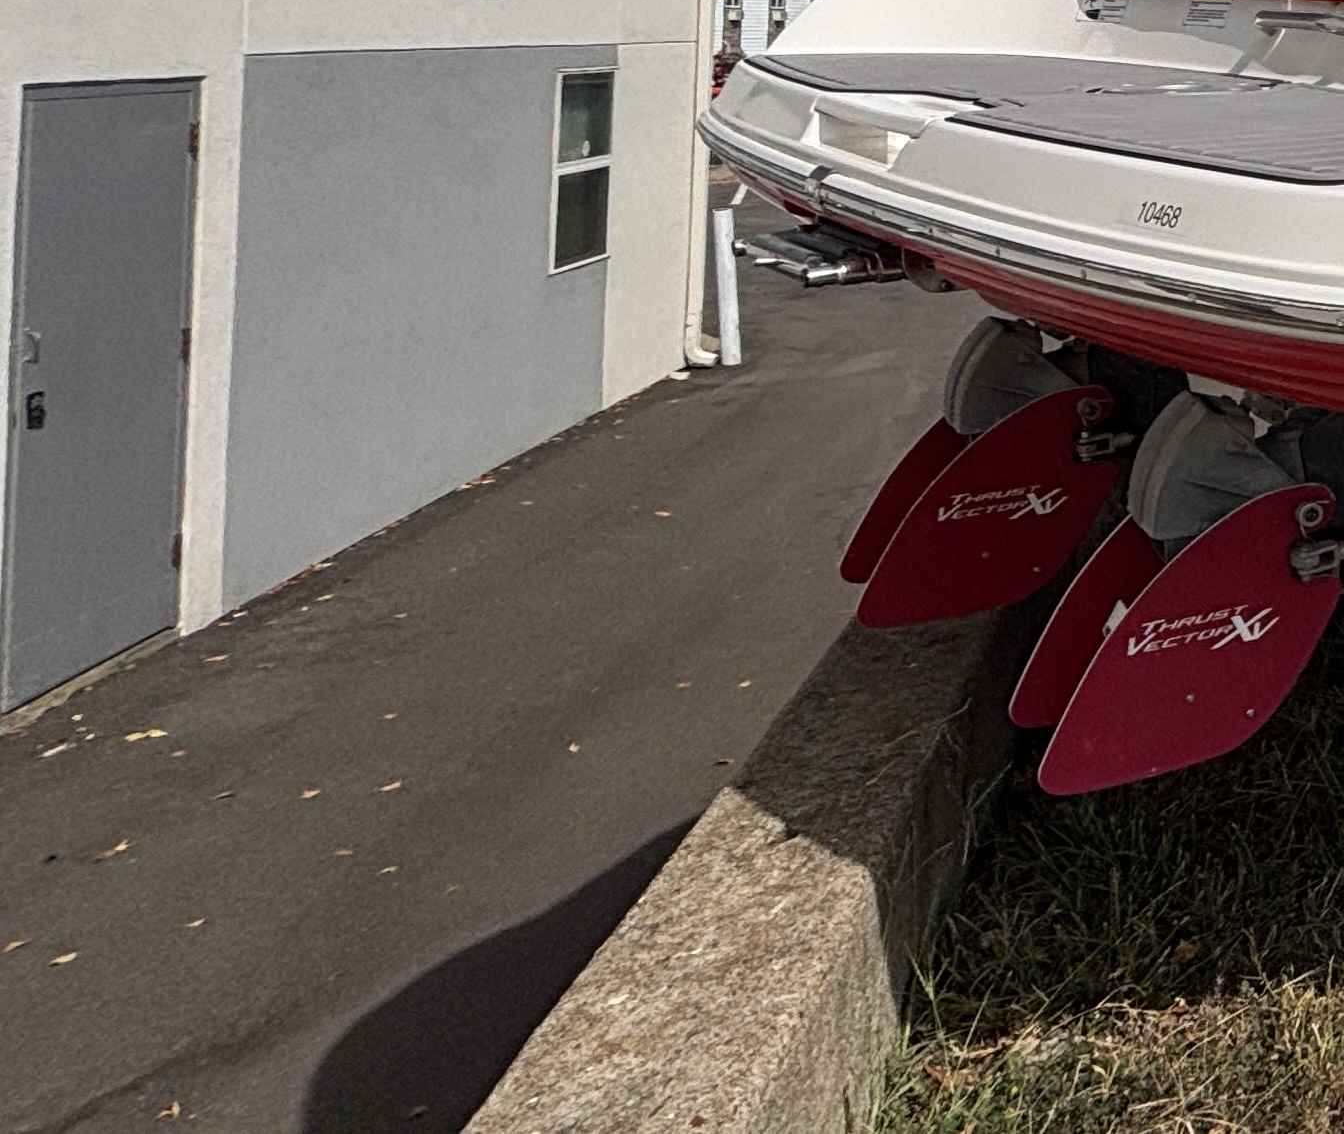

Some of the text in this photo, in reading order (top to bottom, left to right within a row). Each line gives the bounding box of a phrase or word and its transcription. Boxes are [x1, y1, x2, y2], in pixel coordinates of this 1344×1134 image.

[1137, 201, 1182, 228] 10468
[950, 485, 1041, 505] THRUST
[1142, 604, 1249, 635] THRUST
